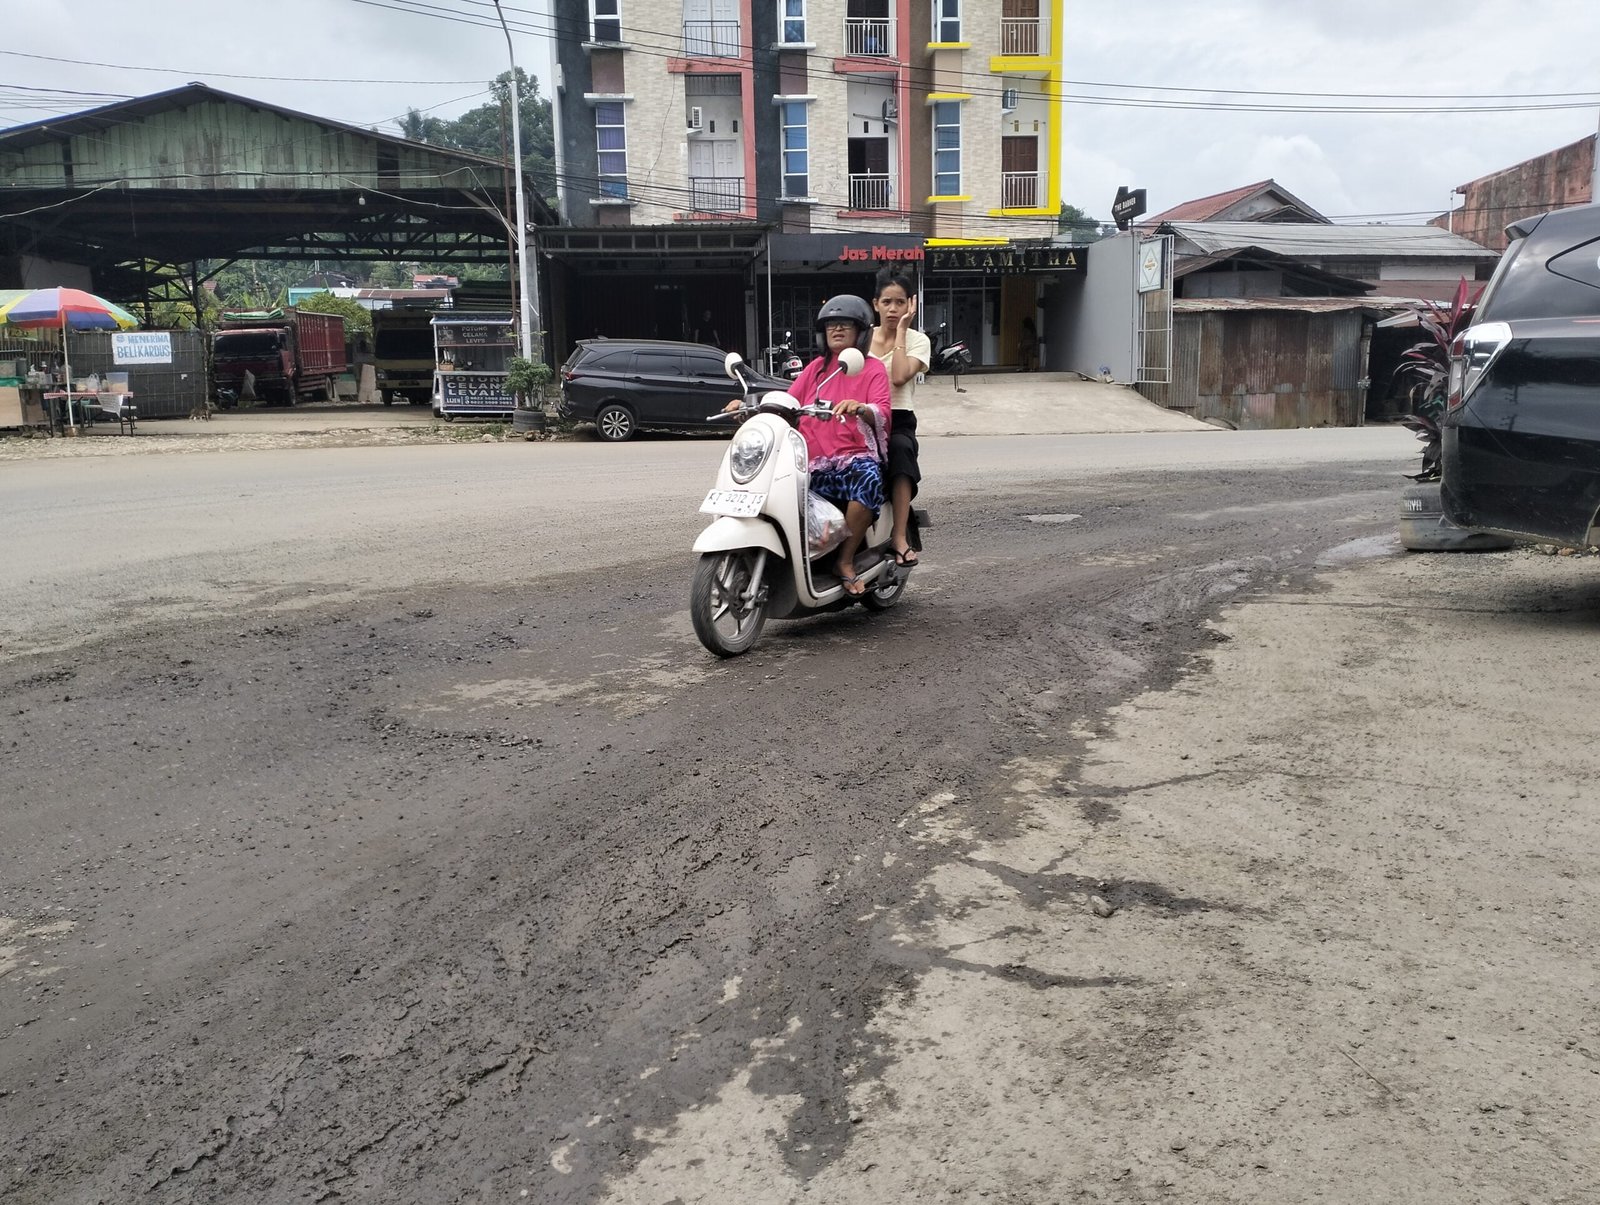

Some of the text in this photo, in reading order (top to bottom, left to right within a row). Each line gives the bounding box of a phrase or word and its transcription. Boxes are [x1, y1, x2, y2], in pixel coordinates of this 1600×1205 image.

[838, 245, 924, 261] Jas Merah
[932, 251, 1077, 267] PARAMITHA
[127, 334, 169, 344] MENERIMA
[708, 492, 723, 502] KT
[725, 493, 748, 504] 3212
